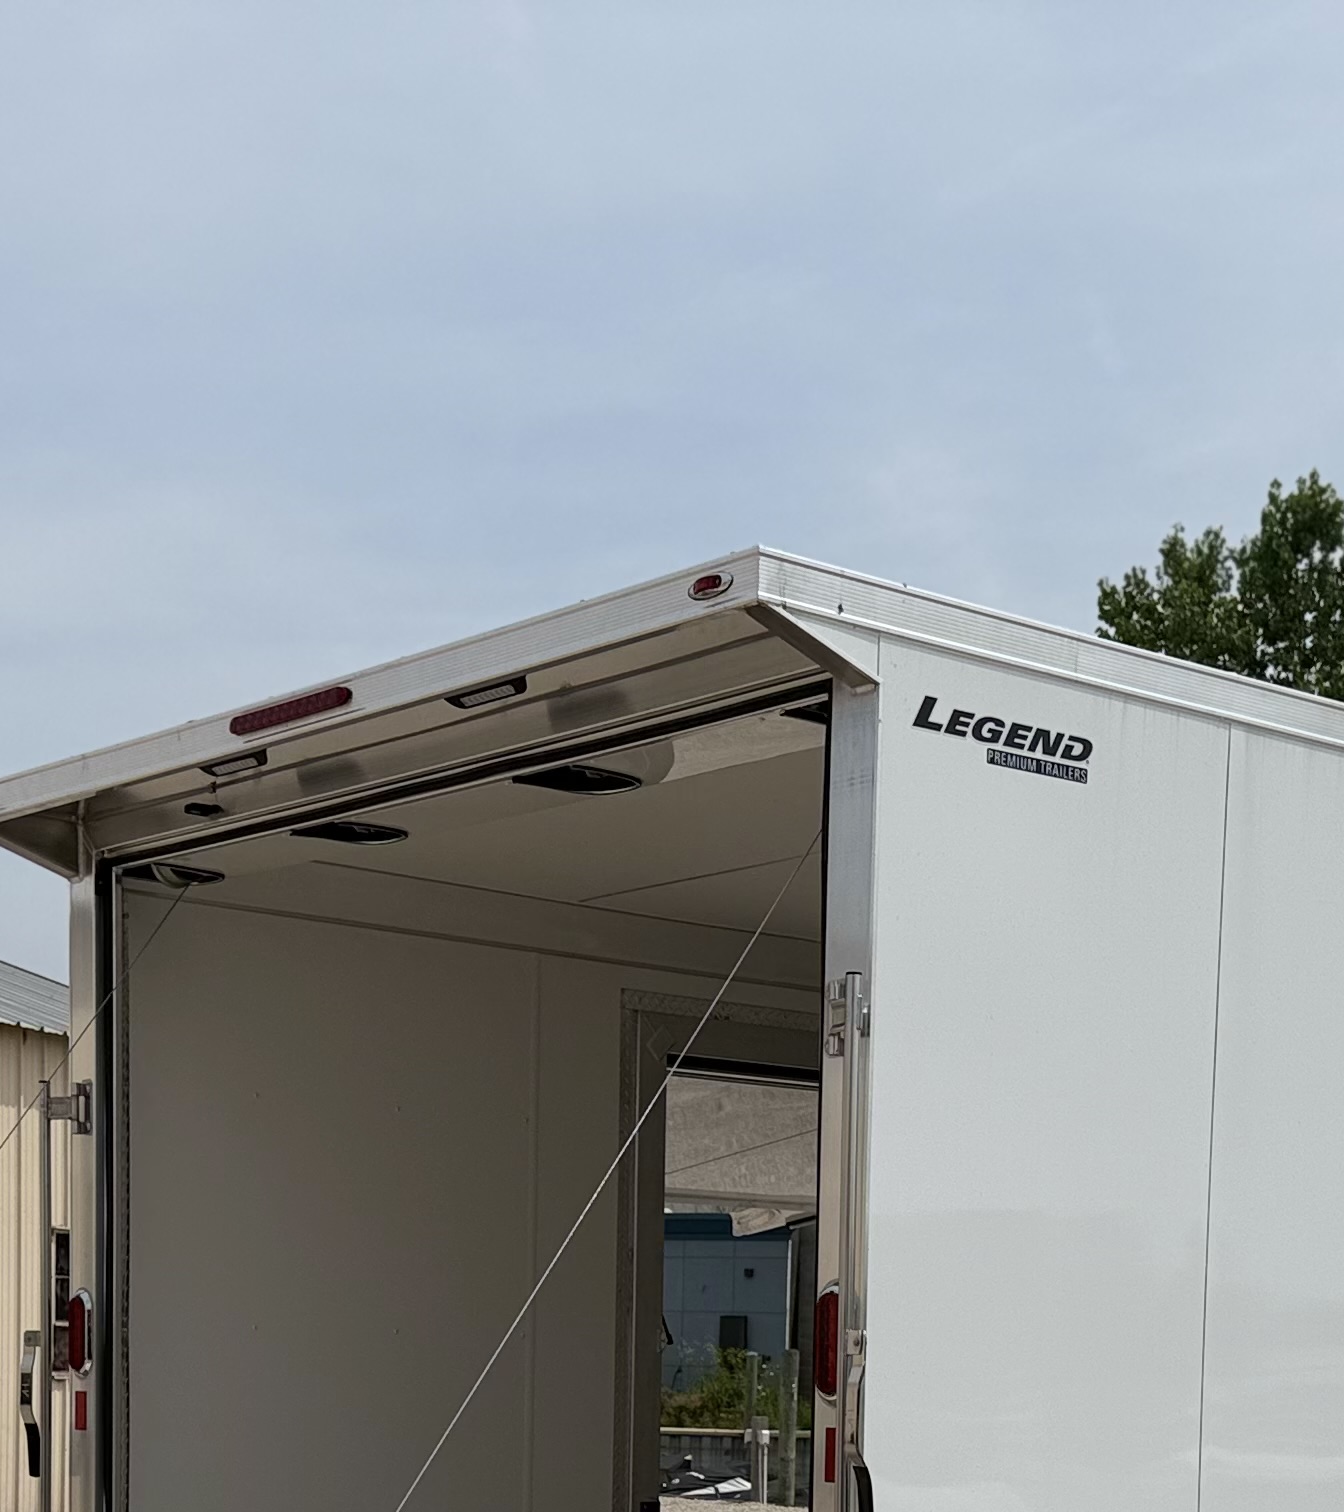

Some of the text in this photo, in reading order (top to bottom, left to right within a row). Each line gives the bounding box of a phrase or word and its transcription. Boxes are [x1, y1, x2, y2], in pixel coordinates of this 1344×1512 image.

[912, 695, 1093, 761] LEGEND
[987, 749, 1087, 783] PREMIUM TRAILERS
